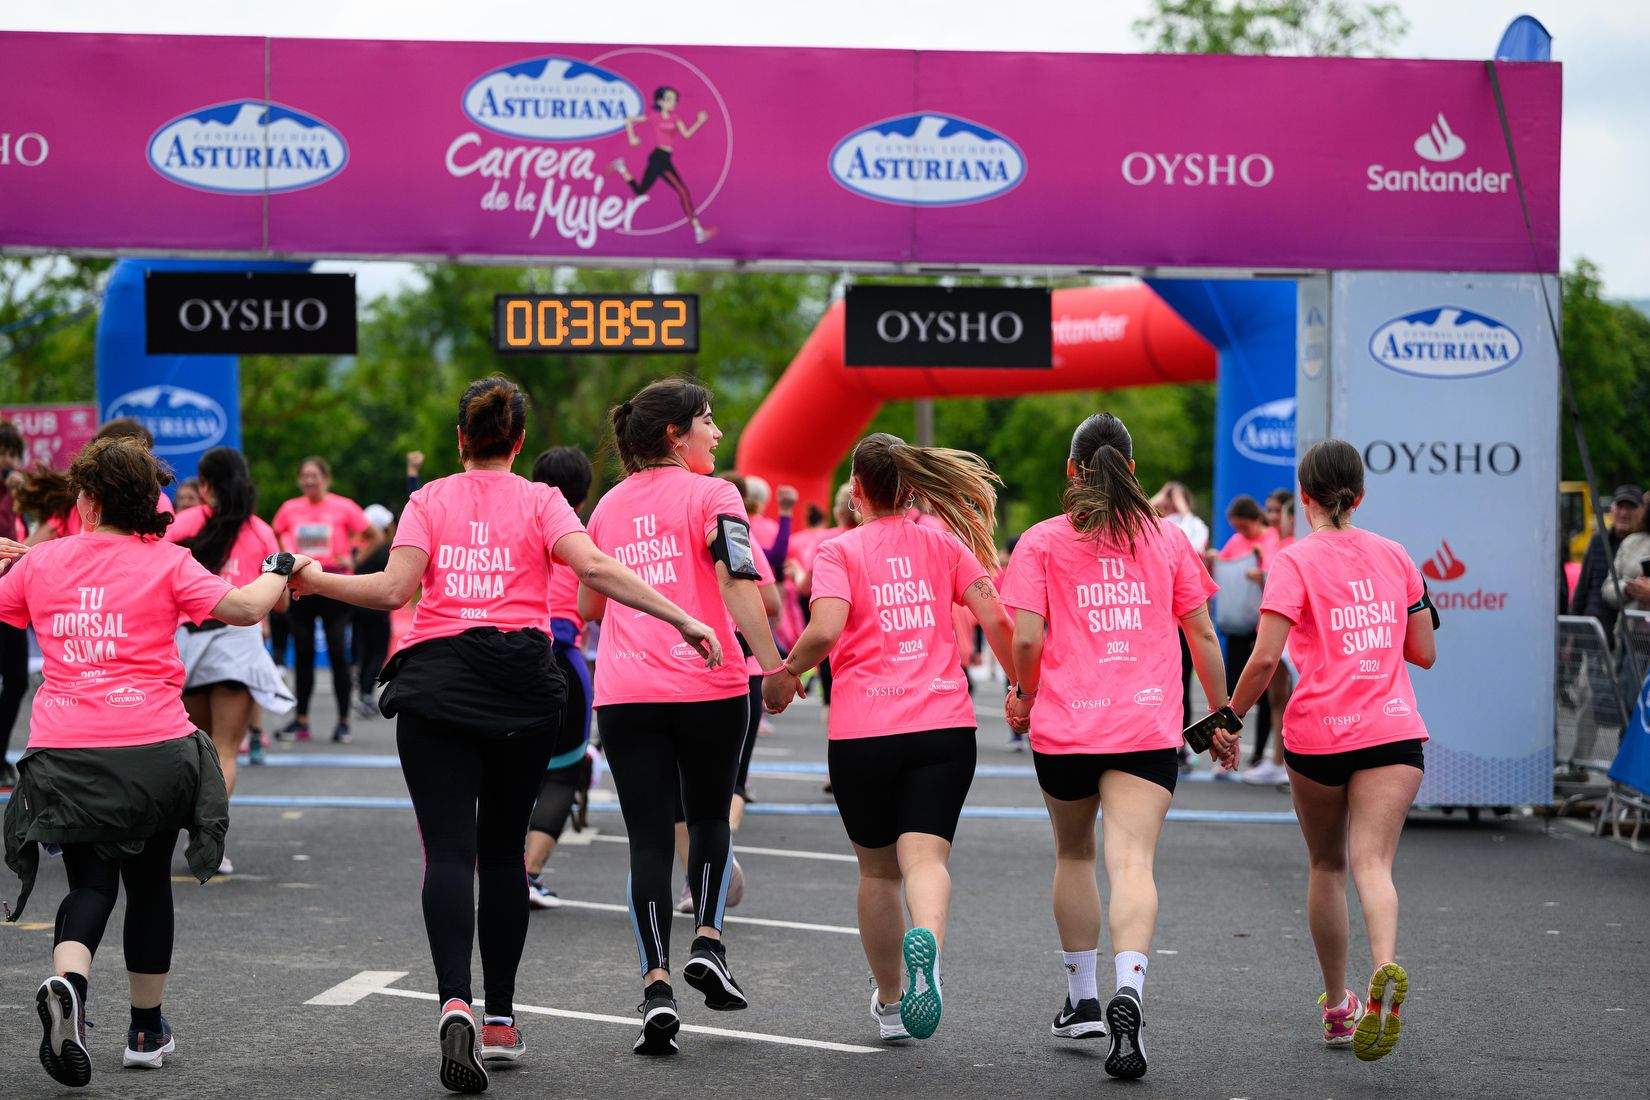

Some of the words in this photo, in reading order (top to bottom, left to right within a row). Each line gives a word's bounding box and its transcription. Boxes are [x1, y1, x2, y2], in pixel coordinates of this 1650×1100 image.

[478, 87, 629, 120] ASTURIANA
[164, 134, 331, 169] ASTURIANA
[445, 132, 597, 180] Carrera
[846, 147, 1009, 181] ASTURIANA
[1121, 151, 1274, 188] OYSHO
[1366, 164, 1512, 194] Santander
[481, 180, 510, 211] de
[513, 180, 537, 211] la
[529, 175, 650, 249] Mujer
[179, 298, 328, 332] OYSHO
[506, 300, 687, 346] 00:38:52
[876, 310, 1024, 344] OYSHO
[1382, 334, 1510, 361] ASTURIANA
[1365, 440, 1522, 476] OYSHO
[469, 520, 490, 545] TU
[632, 513, 657, 539] TU
[437, 544, 516, 572] DORSAL
[614, 535, 683, 567] DORSAL
[633, 560, 678, 587] UMA
[886, 556, 912, 580] TU
[1098, 557, 1125, 580] TU
[78, 586, 105, 610] TU
[444, 572, 505, 599] SUMA
[1076, 581, 1152, 609] DORSAL
[1348, 578, 1375, 603] TU
[52, 612, 128, 637] DORSAL
[460, 607, 488, 619] 2024
[880, 604, 936, 633] SUMA
[1088, 607, 1142, 633] SUMA
[1330, 600, 1398, 631] DORSAL
[63, 638, 118, 664] SUMA
[899, 638, 923, 654] 2024
[1106, 641, 1130, 655] 2024
[1342, 626, 1392, 656] SUMA
[865, 686, 905, 698] OYSHO
[1071, 697, 1111, 710] OYSHO
[1323, 713, 1361, 727] OYSHO
